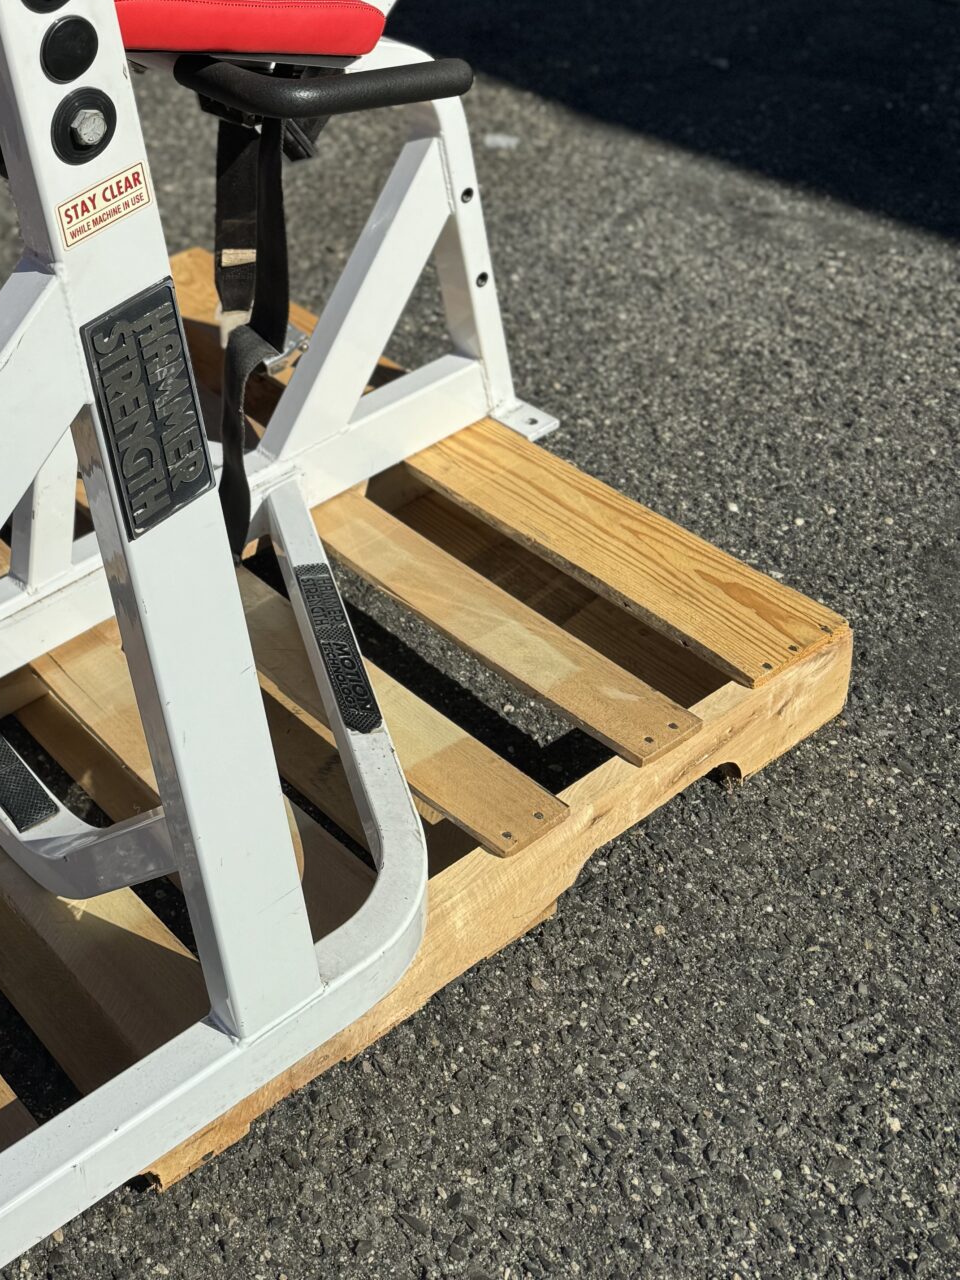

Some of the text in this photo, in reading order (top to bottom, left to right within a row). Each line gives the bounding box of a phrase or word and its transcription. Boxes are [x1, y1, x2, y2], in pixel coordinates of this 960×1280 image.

[64, 171, 142, 225] STAY CLEAR
[70, 192, 145, 240] WHILE MACHINE IN USE
[92, 321, 172, 526] STRENGTH
[133, 301, 205, 492] HAMMER
[300, 577, 330, 627] STRENGTH
[317, 577, 344, 624] HAMMER
[321, 641, 359, 713] TECHNOLOGY
[333, 641, 375, 713] MOTION
